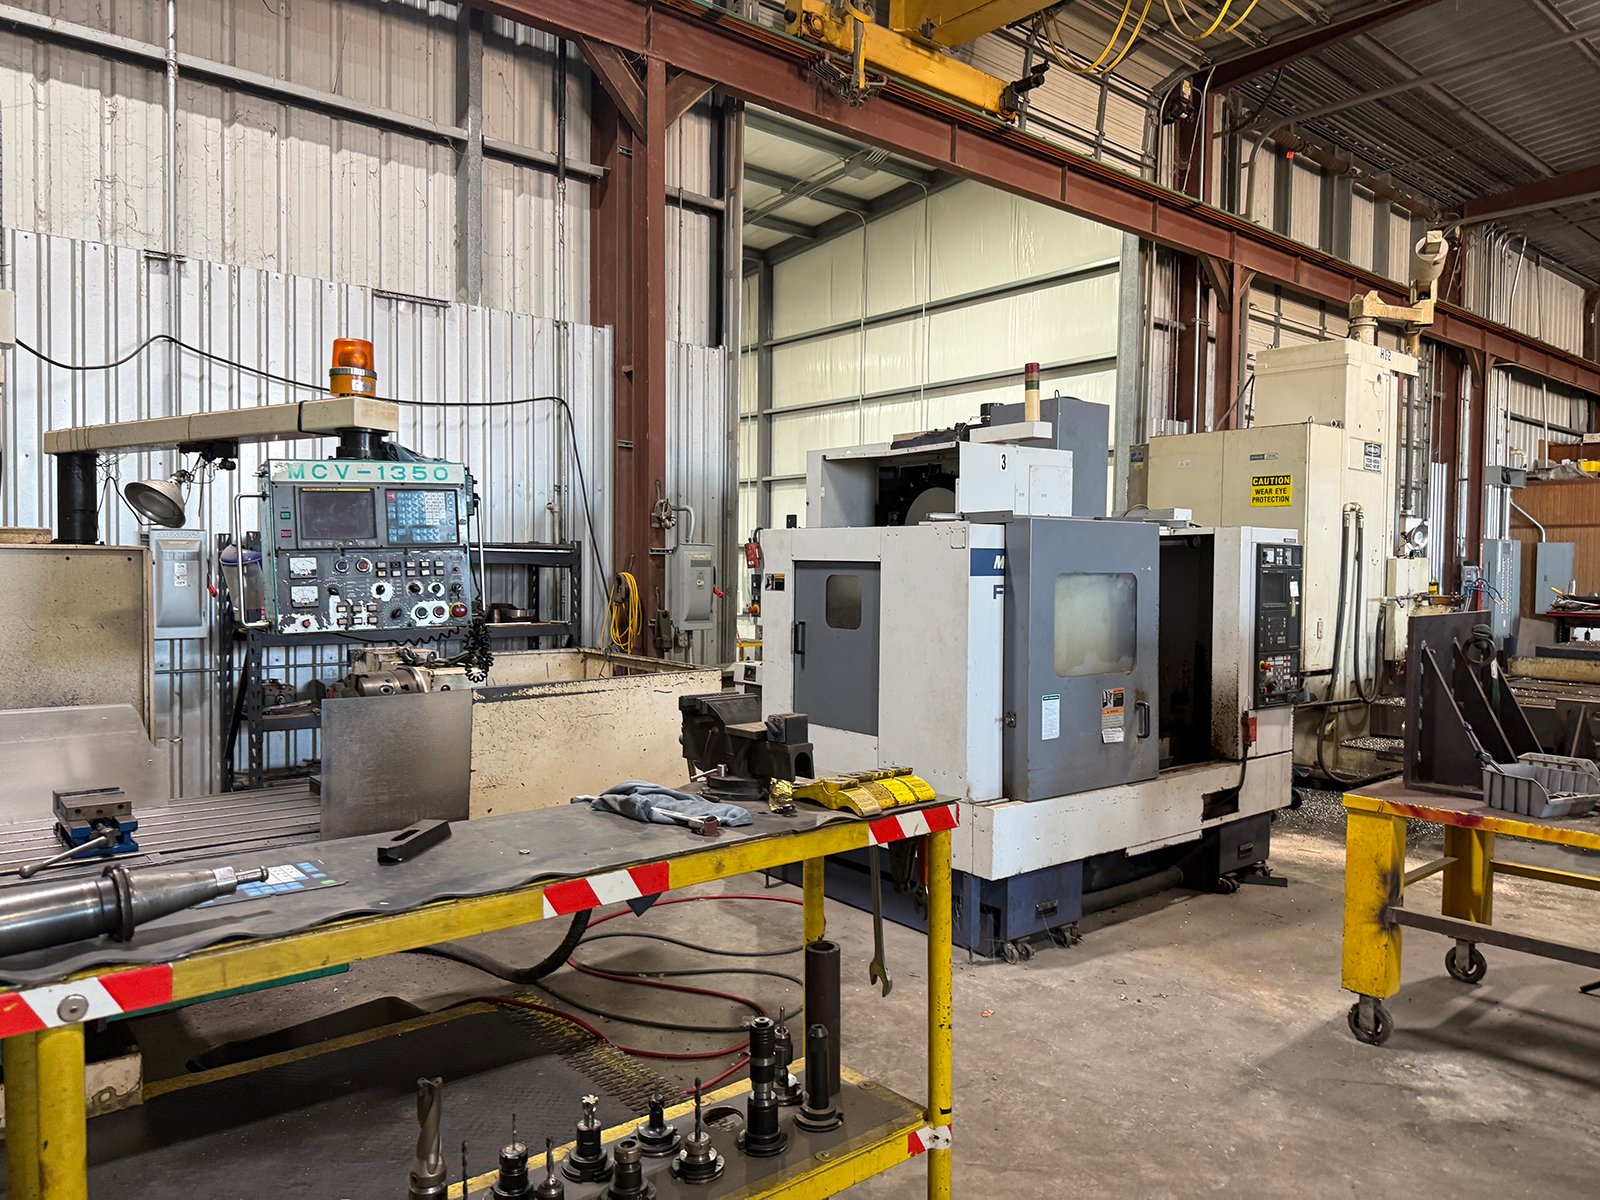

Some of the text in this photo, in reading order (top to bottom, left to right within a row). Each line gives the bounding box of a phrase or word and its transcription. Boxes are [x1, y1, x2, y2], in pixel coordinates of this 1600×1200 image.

[1001, 453, 1007, 470] 3
[288, 464, 449, 481] MCV-1350
[1252, 476, 1290, 485] CAUTION
